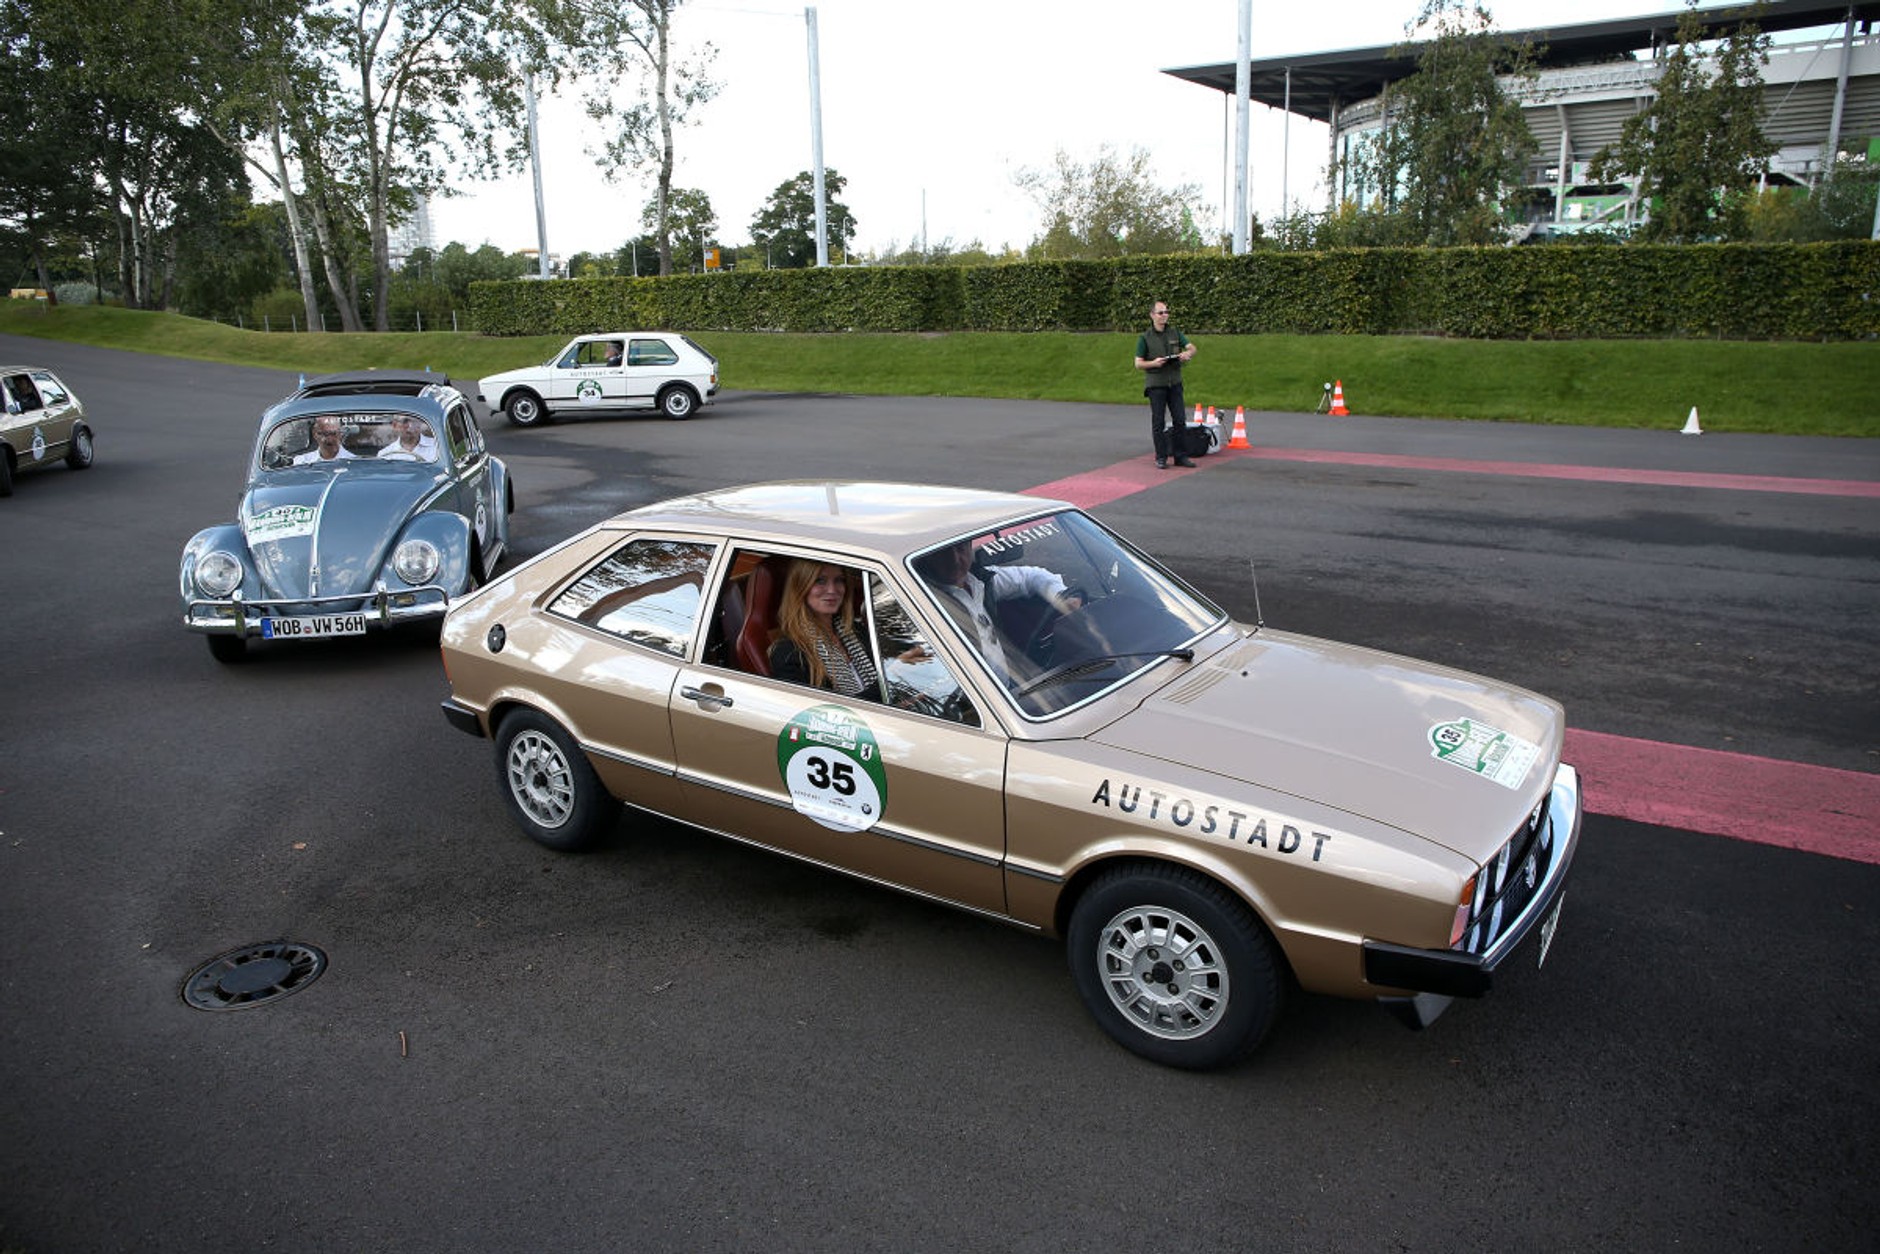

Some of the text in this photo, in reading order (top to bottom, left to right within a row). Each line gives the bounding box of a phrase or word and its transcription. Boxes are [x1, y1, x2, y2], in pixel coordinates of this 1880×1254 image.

[981, 523, 1060, 556] AUTOSTADT
[272, 616, 364, 635] WOB VW 56H
[1441, 729, 1461, 743] 35
[807, 756, 856, 796] 35
[1092, 779, 1332, 862] AUTOSTADT
